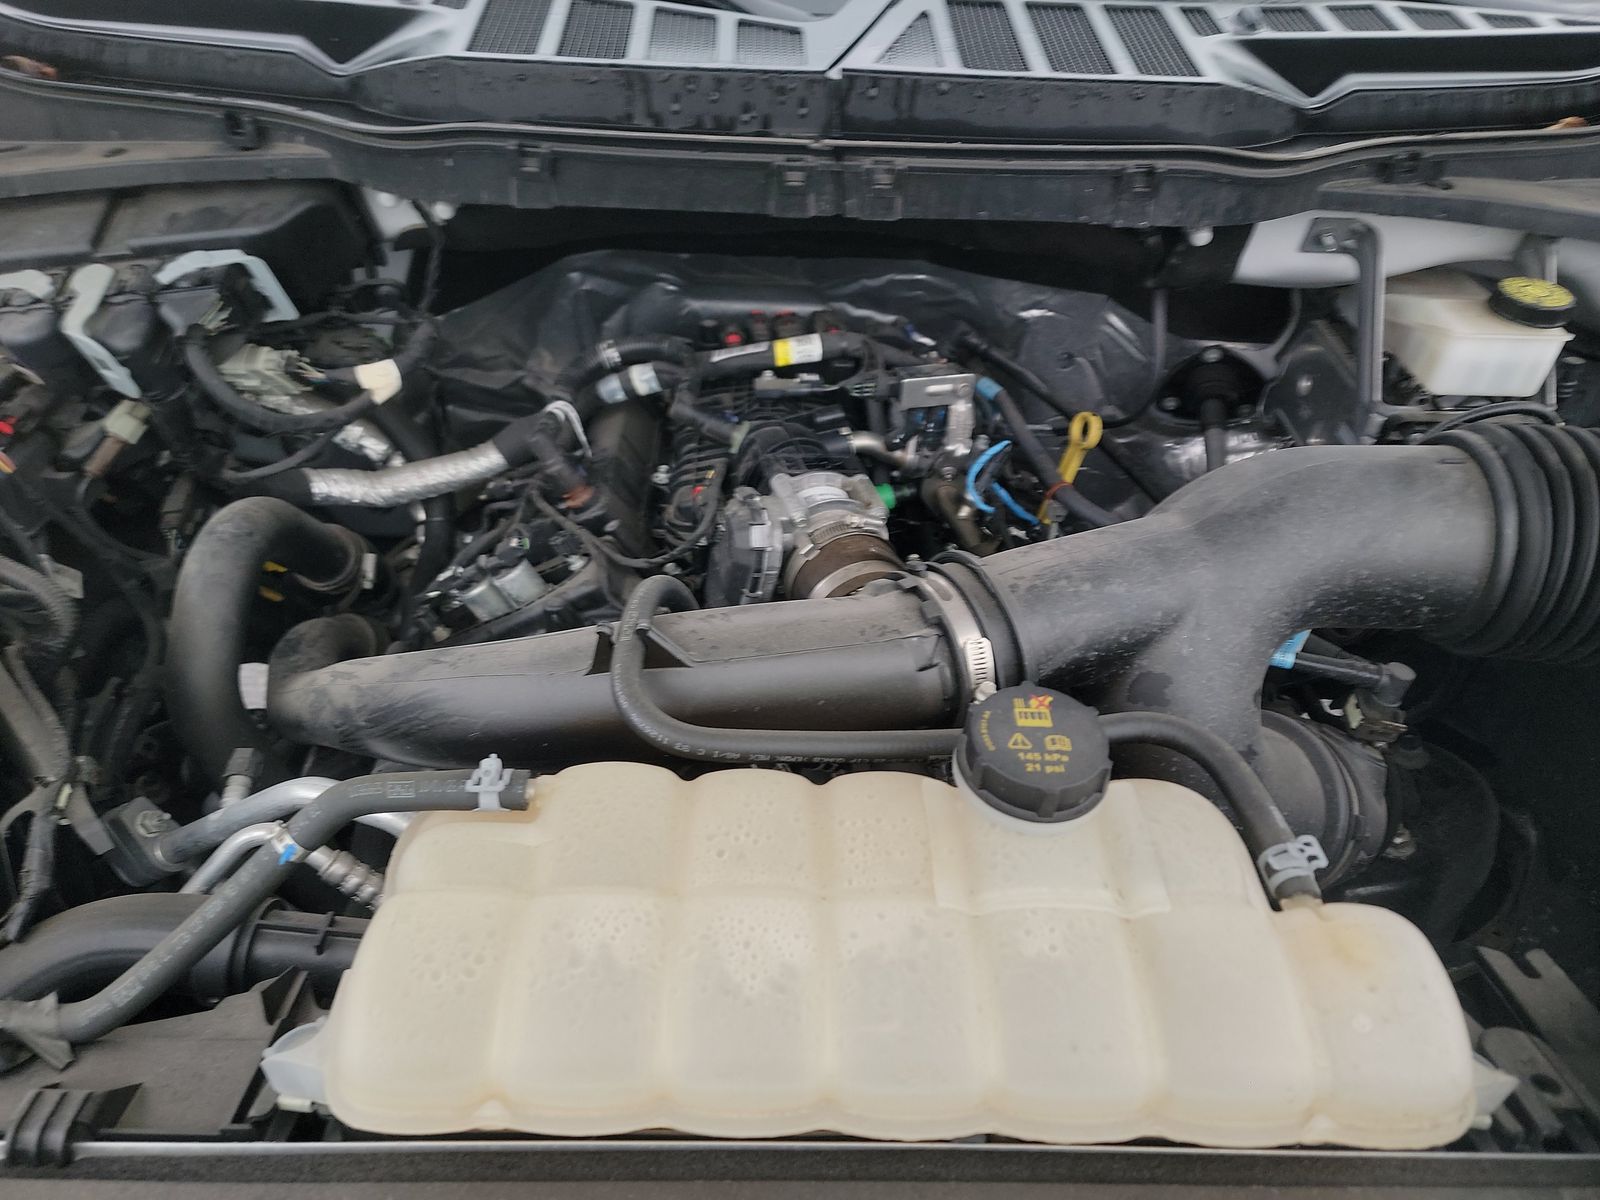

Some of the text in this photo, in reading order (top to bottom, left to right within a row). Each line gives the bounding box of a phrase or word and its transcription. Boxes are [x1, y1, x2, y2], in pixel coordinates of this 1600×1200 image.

[1017, 751, 1070, 762] 145 kPa
[1024, 762, 1066, 774] 21 psi
